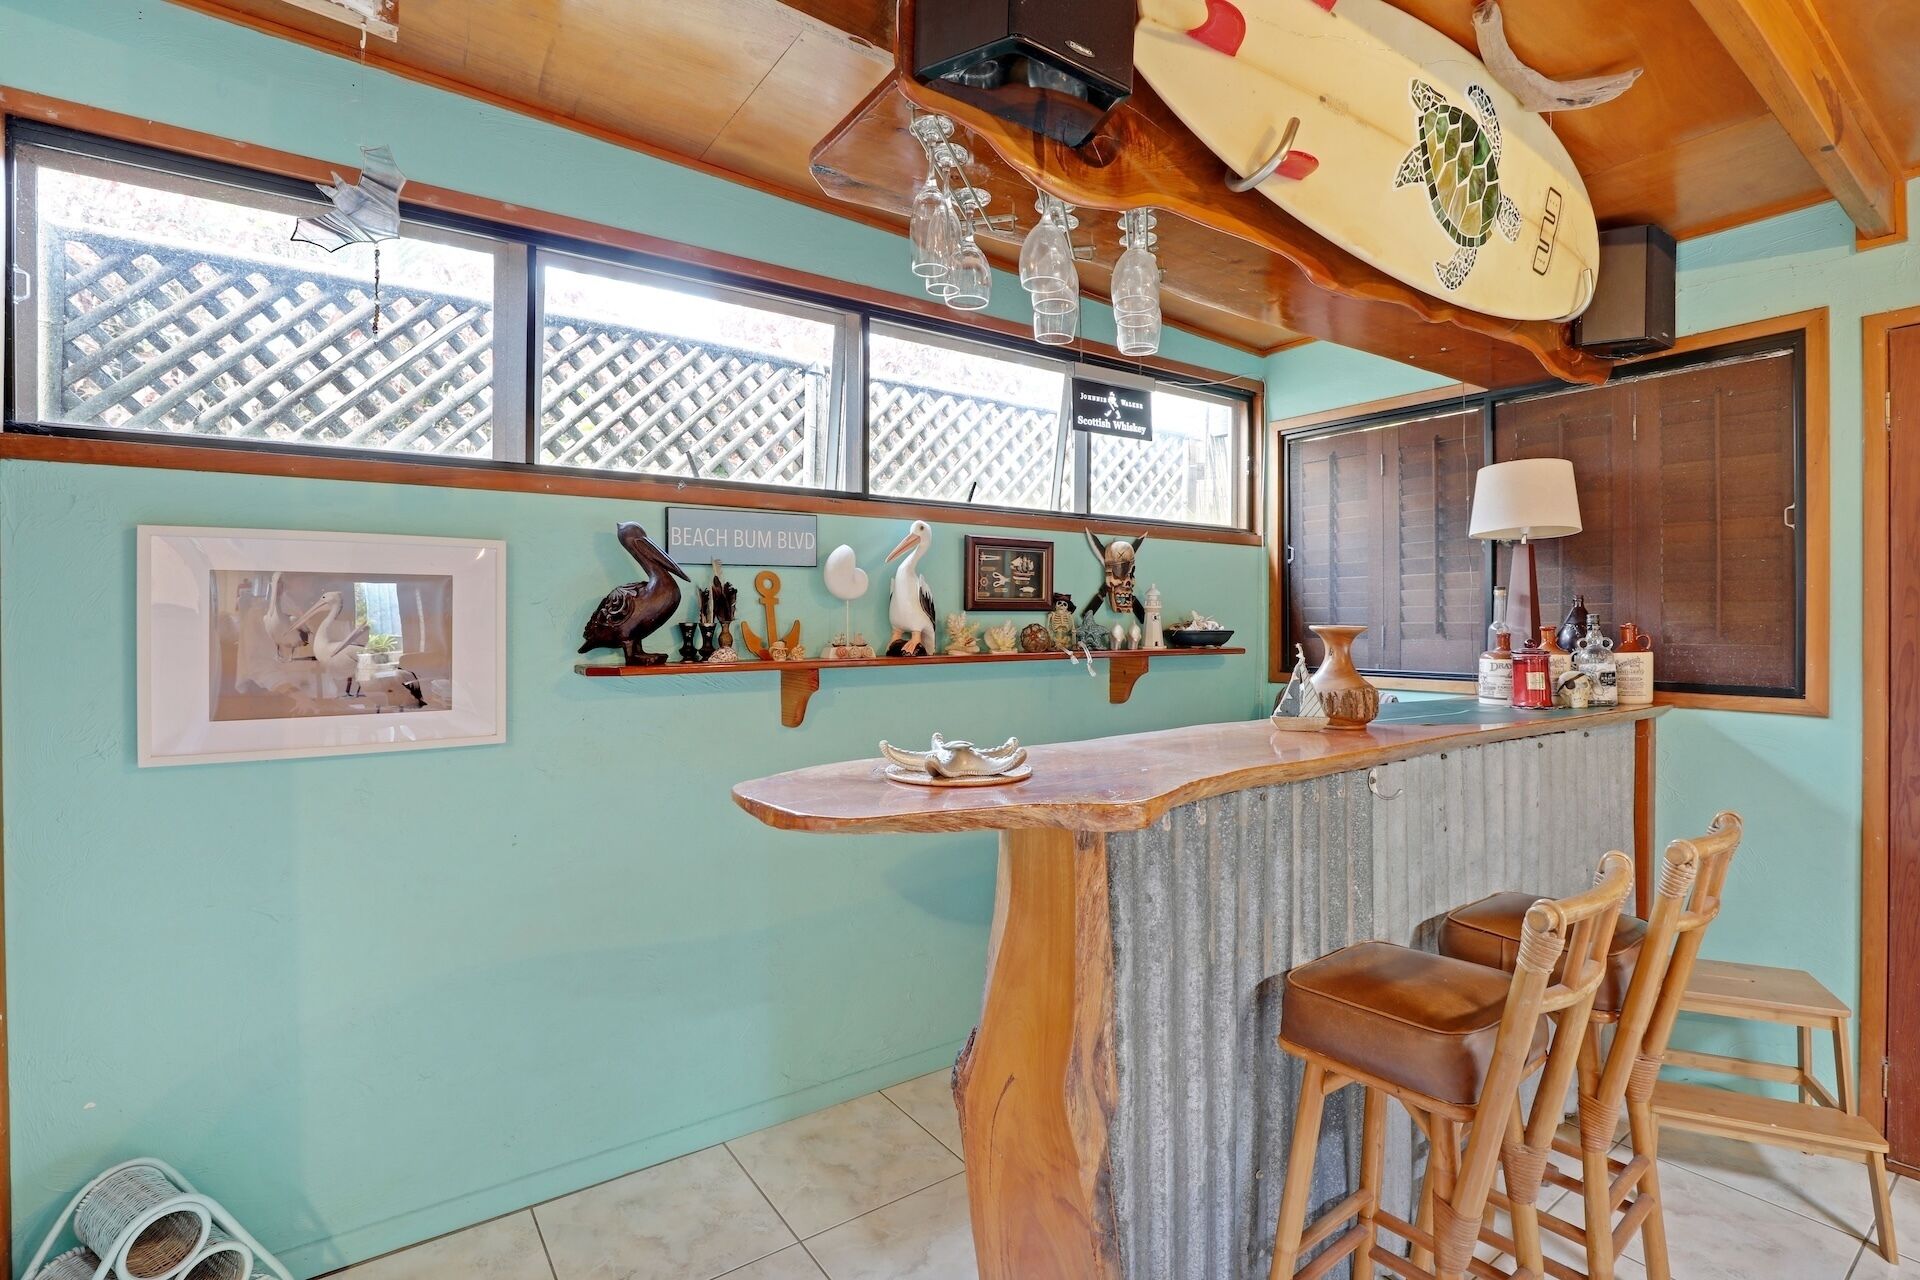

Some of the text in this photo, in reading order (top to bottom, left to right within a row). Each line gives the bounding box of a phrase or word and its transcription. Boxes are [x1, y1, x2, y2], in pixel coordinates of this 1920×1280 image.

[1120, 399, 1144, 409] WALKER
[1077, 415, 1147, 435] Scottish Whiskey
[671, 526, 815, 550] BEACH BUM BLVD
